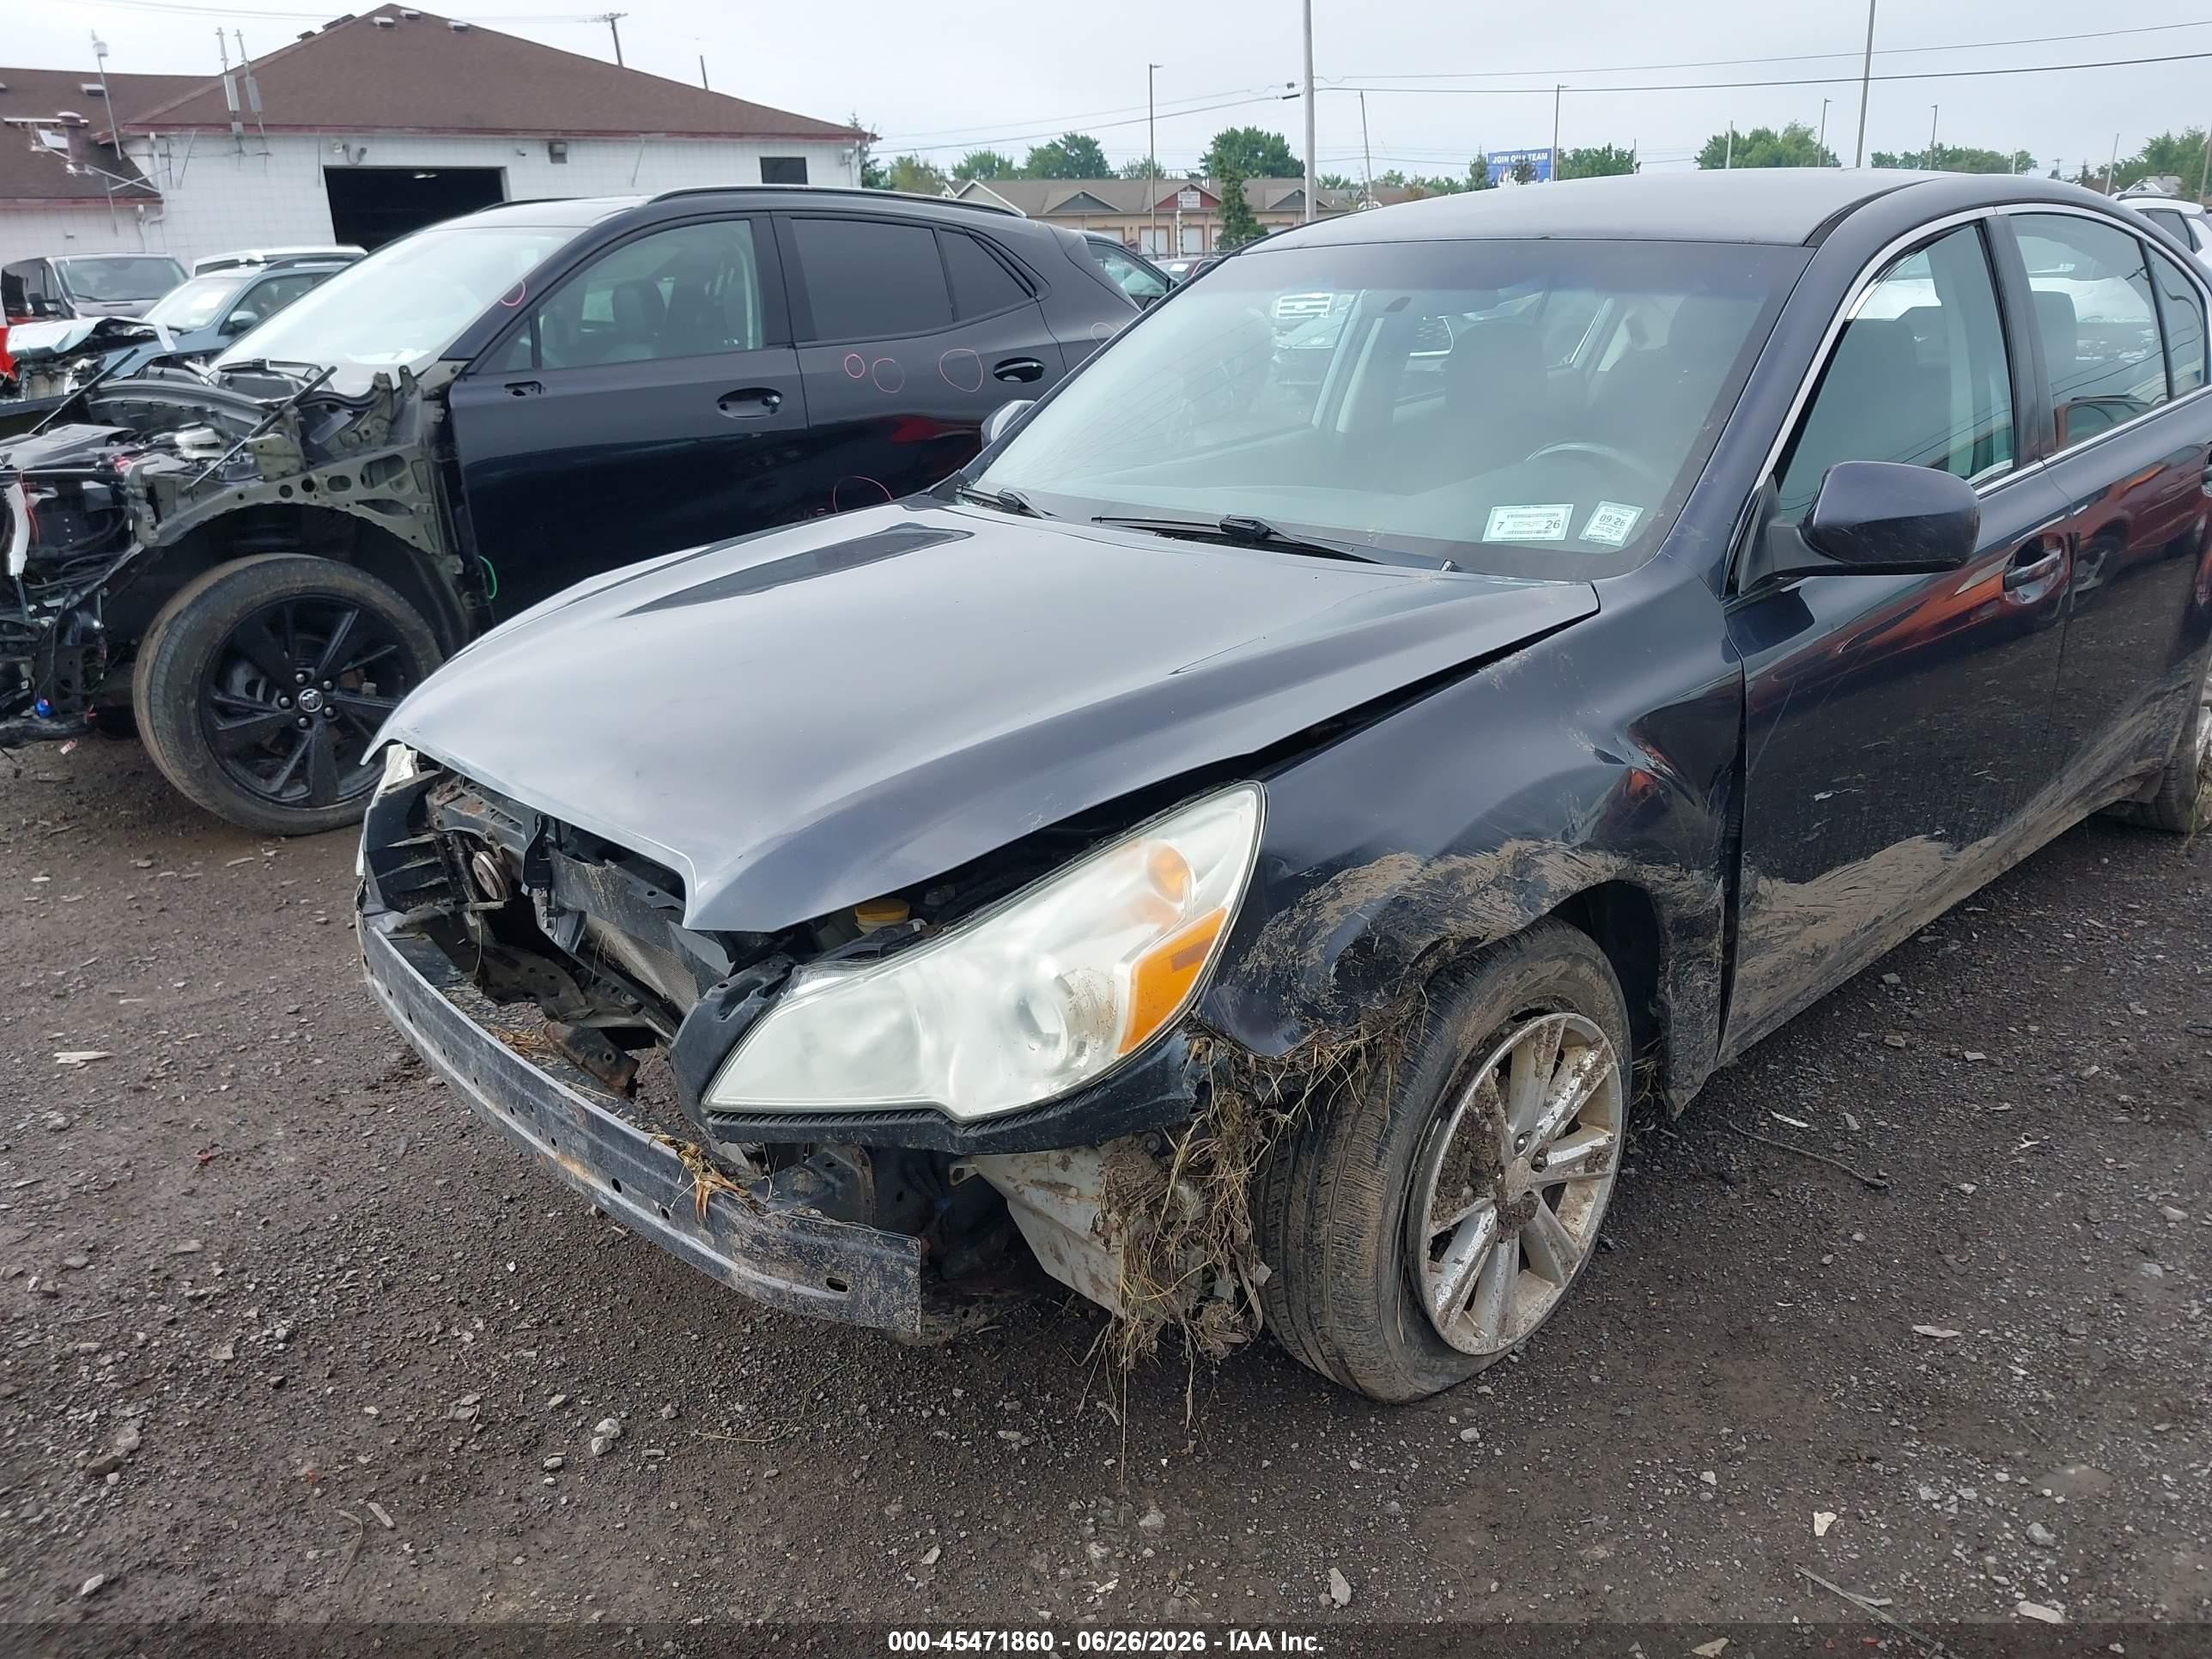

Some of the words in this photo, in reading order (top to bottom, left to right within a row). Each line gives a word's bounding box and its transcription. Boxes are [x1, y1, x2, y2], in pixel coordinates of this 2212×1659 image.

[1492, 155, 1510, 164] JOIN
[1528, 152, 1547, 161] TEAM
[1497, 521, 1505, 531] 7
[1544, 519, 1561, 530] 26
[1599, 514, 1613, 523] 09
[1613, 517, 1627, 527] 26
